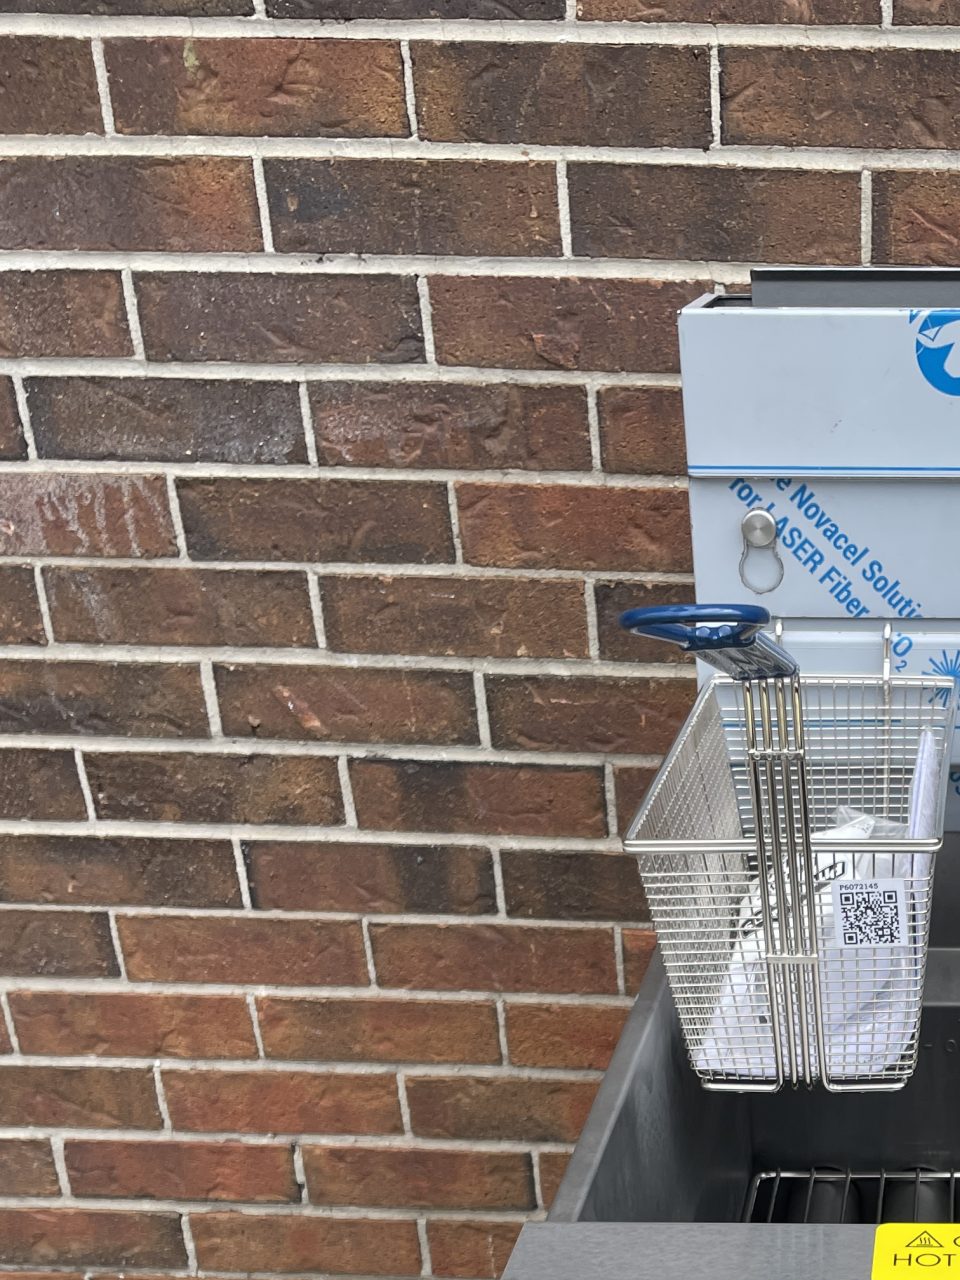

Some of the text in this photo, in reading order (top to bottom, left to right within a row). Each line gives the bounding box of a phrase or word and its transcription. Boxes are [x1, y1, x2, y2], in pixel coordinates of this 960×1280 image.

[766, 503, 825, 575] ASER
[818, 565, 871, 618] Fiber
[790, 483, 869, 567] Novacel
[893, 1253, 956, 1268] HOT
